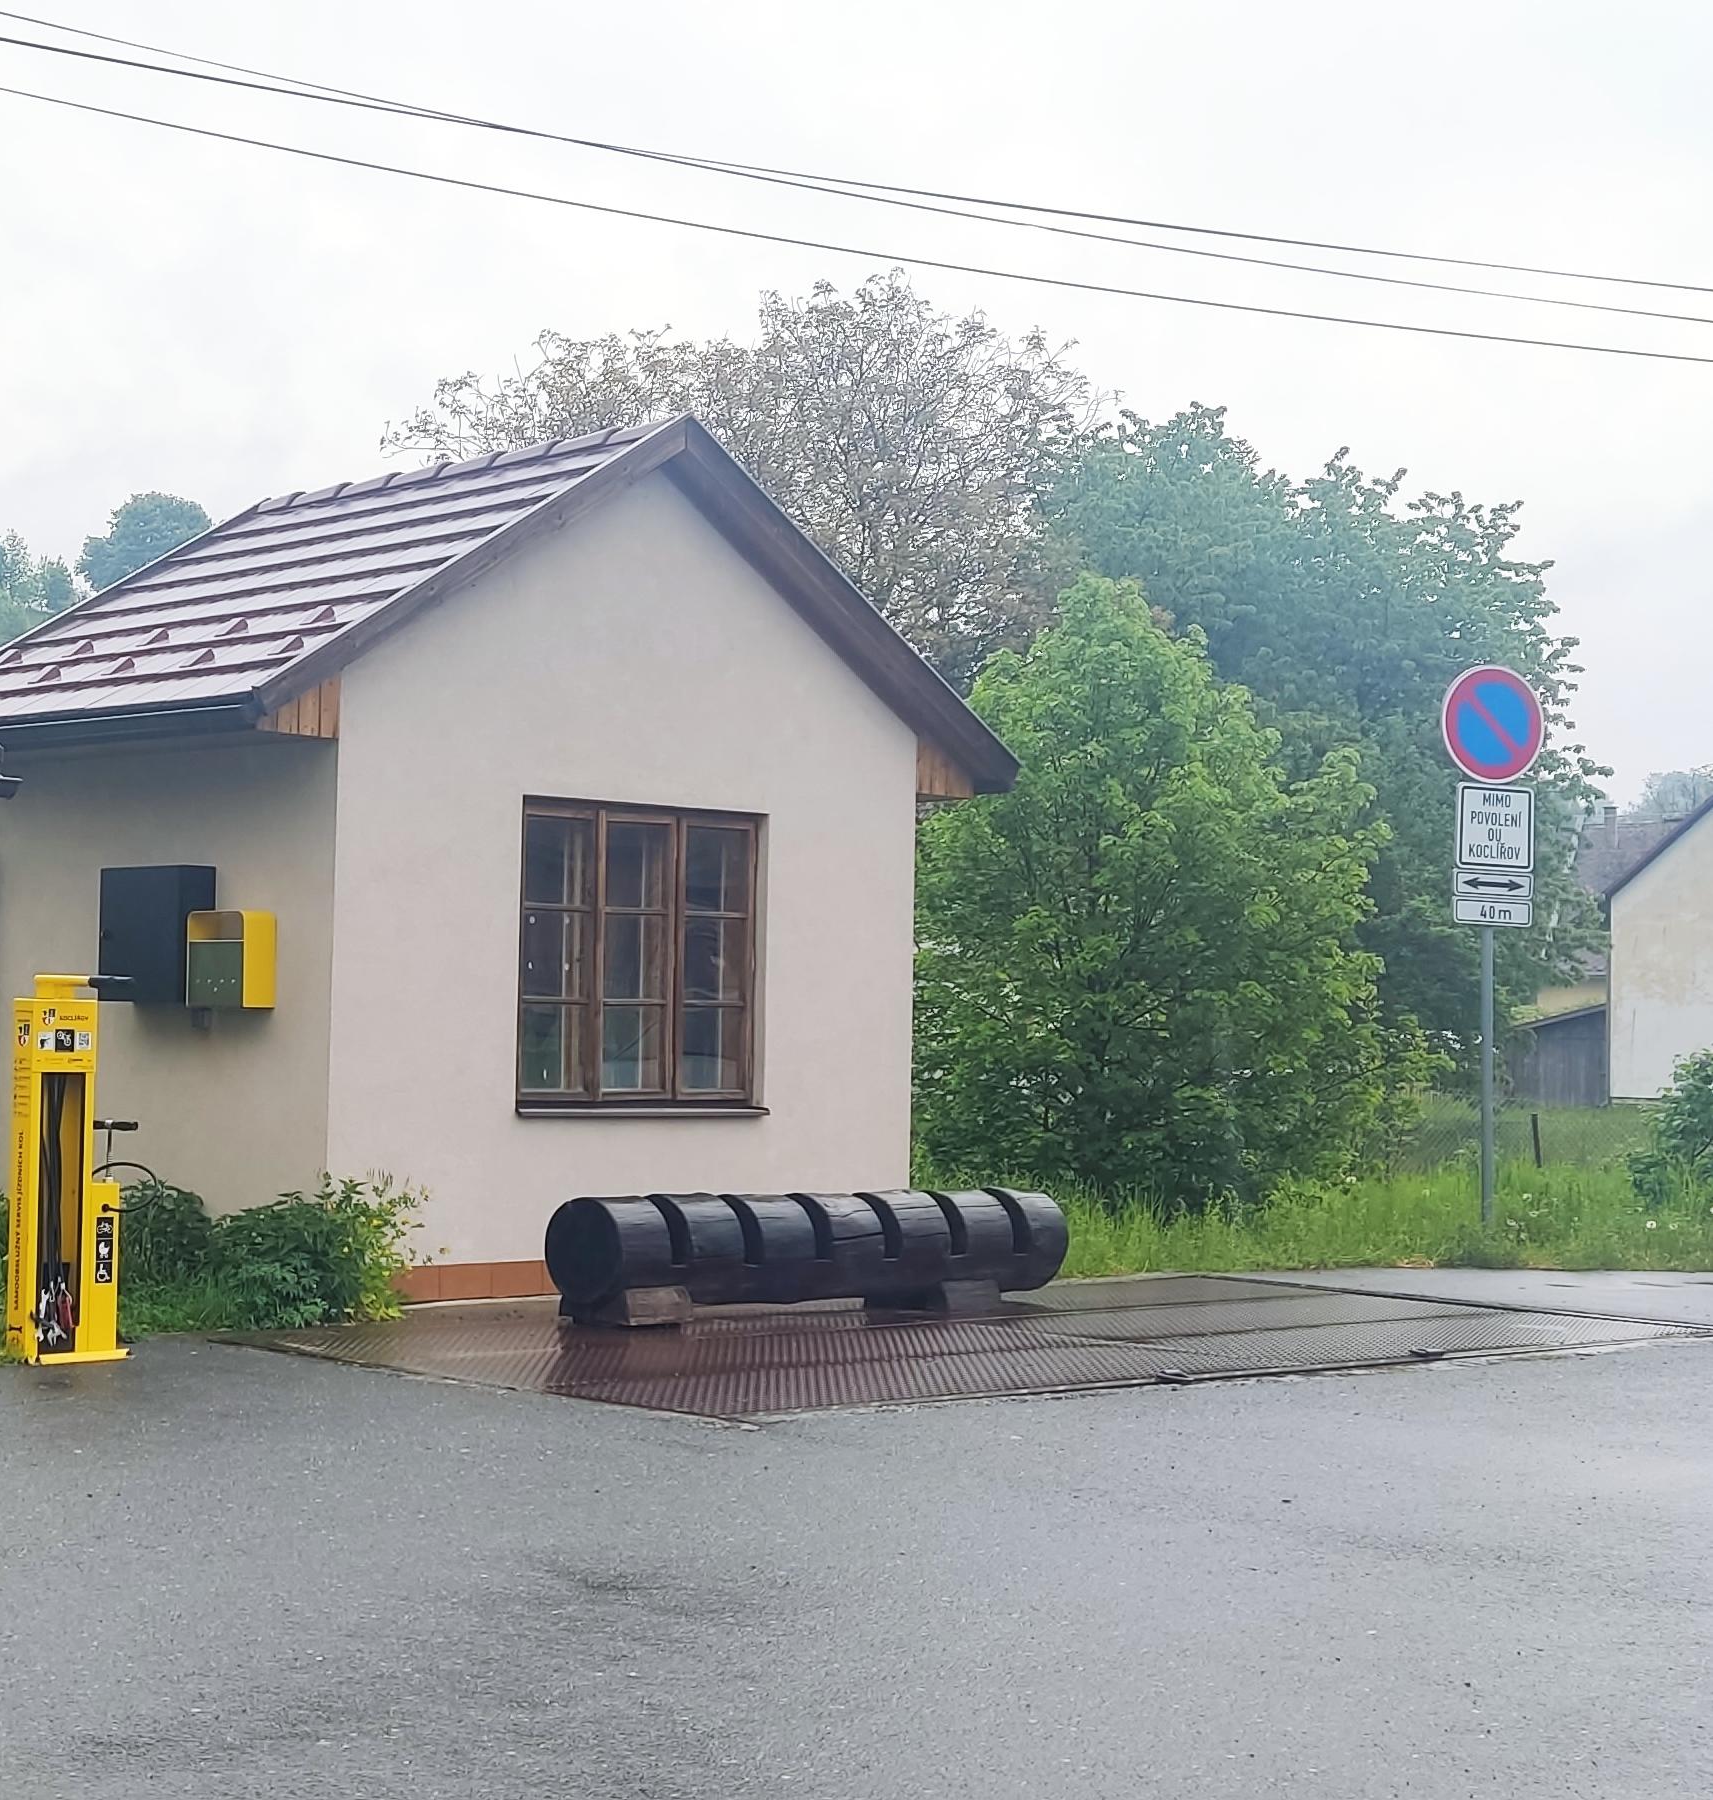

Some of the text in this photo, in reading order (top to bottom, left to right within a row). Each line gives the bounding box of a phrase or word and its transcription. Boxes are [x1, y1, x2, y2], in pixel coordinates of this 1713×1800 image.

[1482, 792, 1511, 808] MIMO
[1470, 810, 1522, 828] POVOLENÍ
[1487, 828, 1502, 842] OU
[1468, 842, 1521, 860] KOCLÍŘOV
[1480, 905, 1512, 920] 40 m
